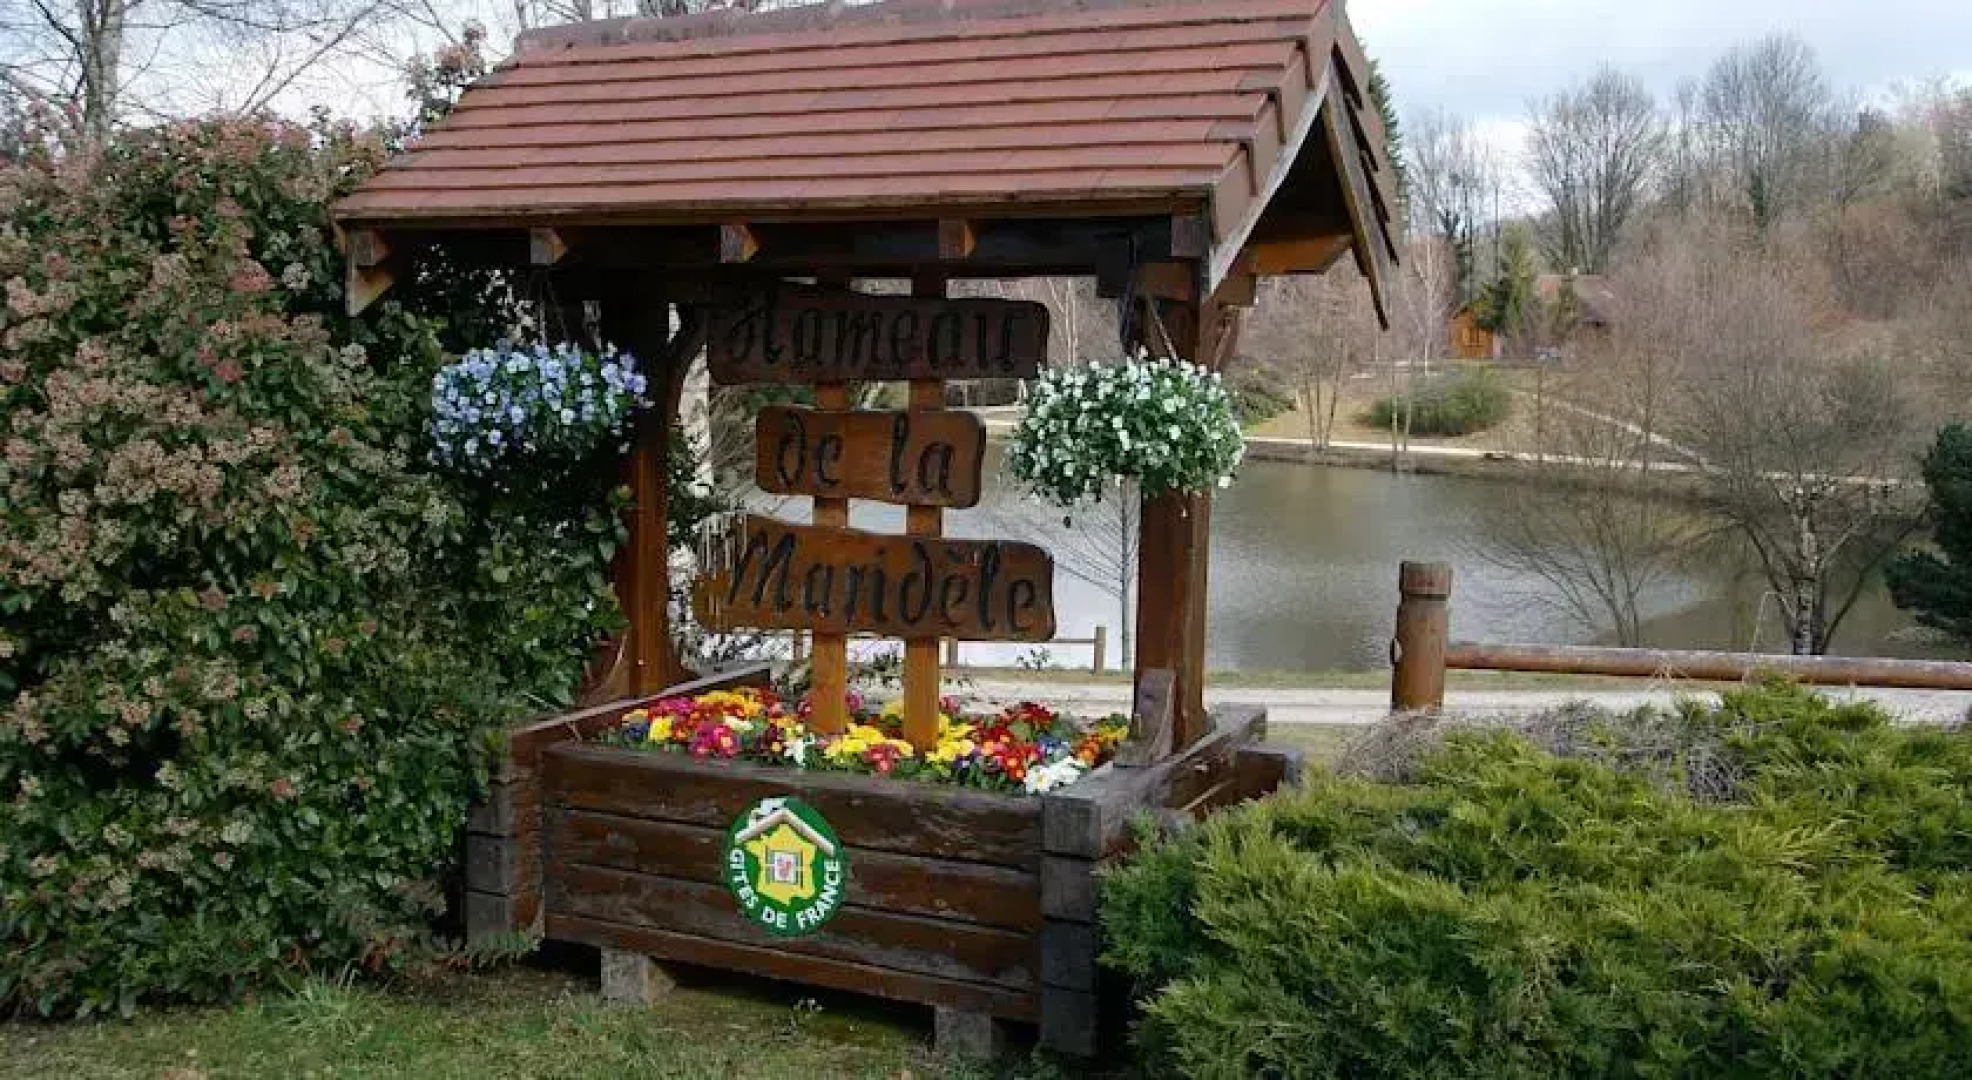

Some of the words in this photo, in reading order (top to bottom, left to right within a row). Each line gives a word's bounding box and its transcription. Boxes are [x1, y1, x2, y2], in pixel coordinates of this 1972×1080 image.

[726, 289, 1022, 370] Hameau
[777, 411, 842, 487] de
[889, 412, 956, 497] la
[730, 530, 1036, 631] Maridèle
[761, 905, 787, 928] DE
[796, 859, 840, 929] FRANCE
